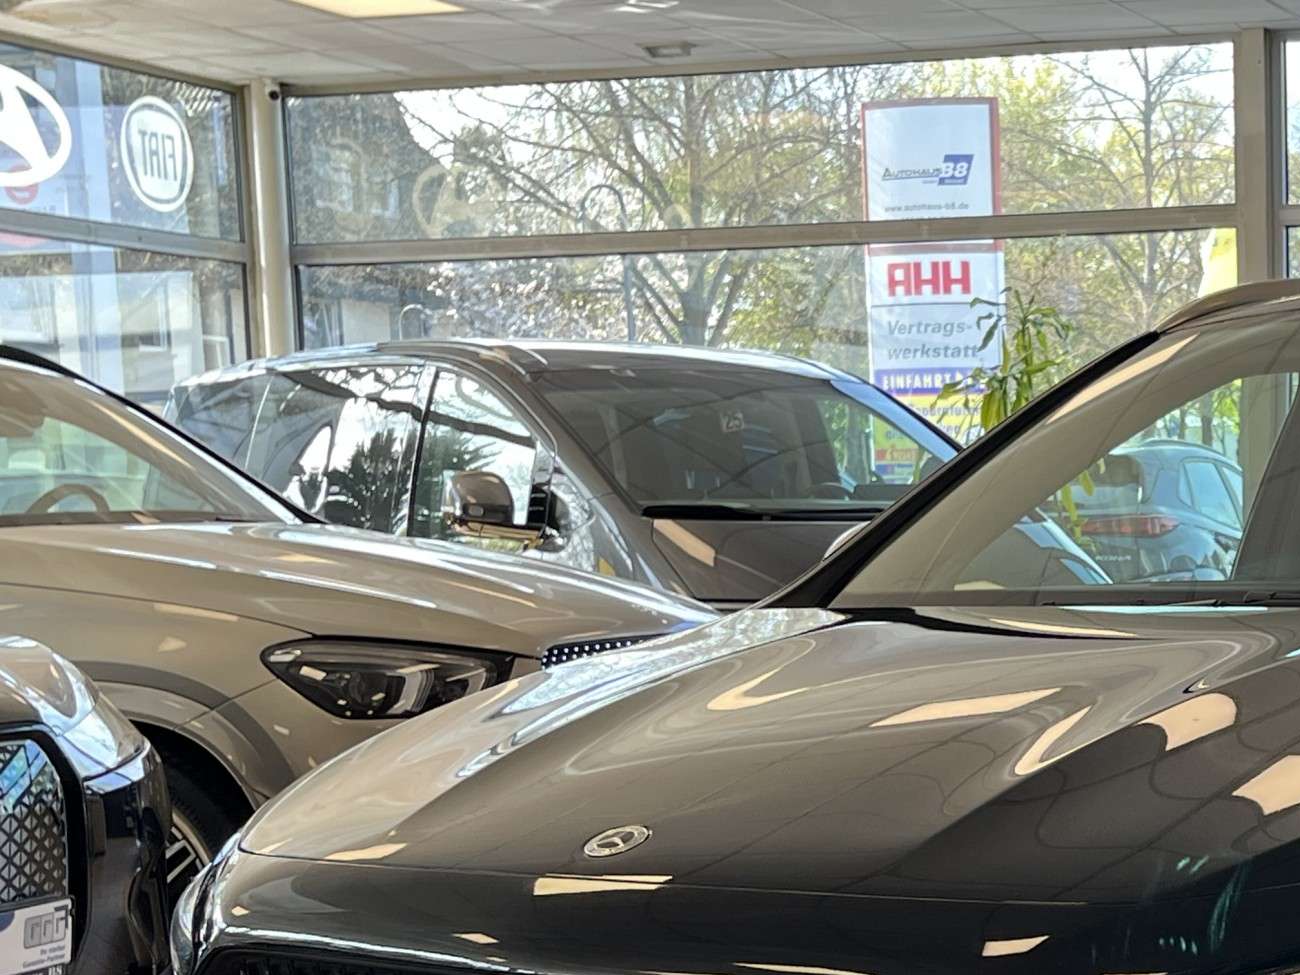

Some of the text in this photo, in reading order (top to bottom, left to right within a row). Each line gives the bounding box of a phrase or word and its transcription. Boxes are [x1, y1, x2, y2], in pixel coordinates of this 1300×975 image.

[941, 161, 969, 178] B8
[888, 261, 971, 297] AHH
[888, 320, 972, 337] Vertrags-
[888, 344, 978, 360] werkstatt
[883, 372, 952, 390] EINFAHRT
